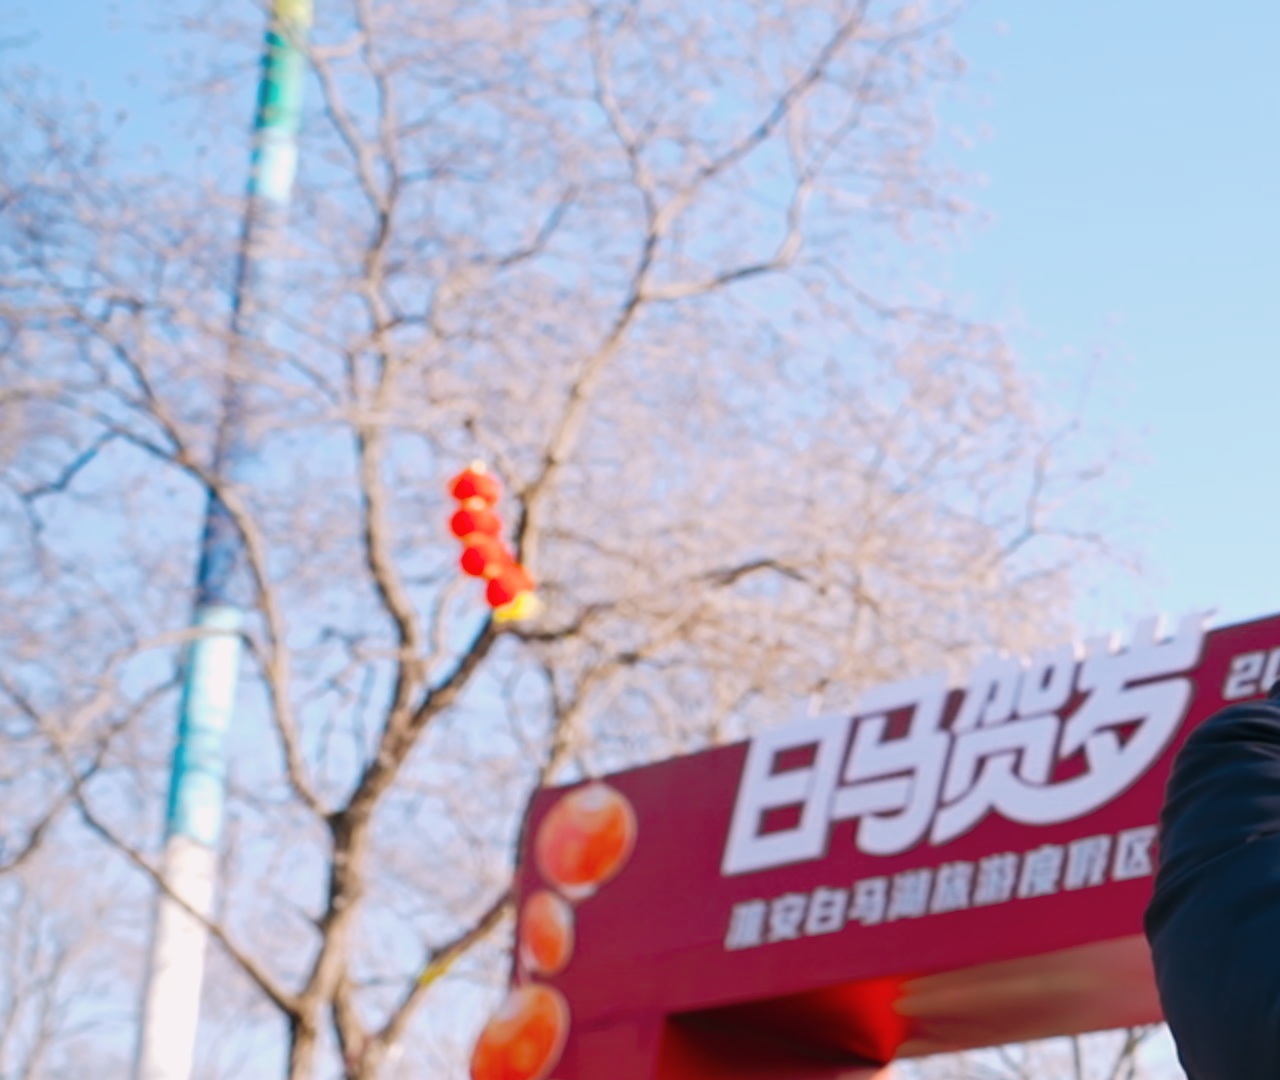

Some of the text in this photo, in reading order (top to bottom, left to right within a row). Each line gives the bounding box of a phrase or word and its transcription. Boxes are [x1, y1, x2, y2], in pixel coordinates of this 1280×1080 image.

[724, 825, 1158, 951] 淮安白马湖旅游度假区
